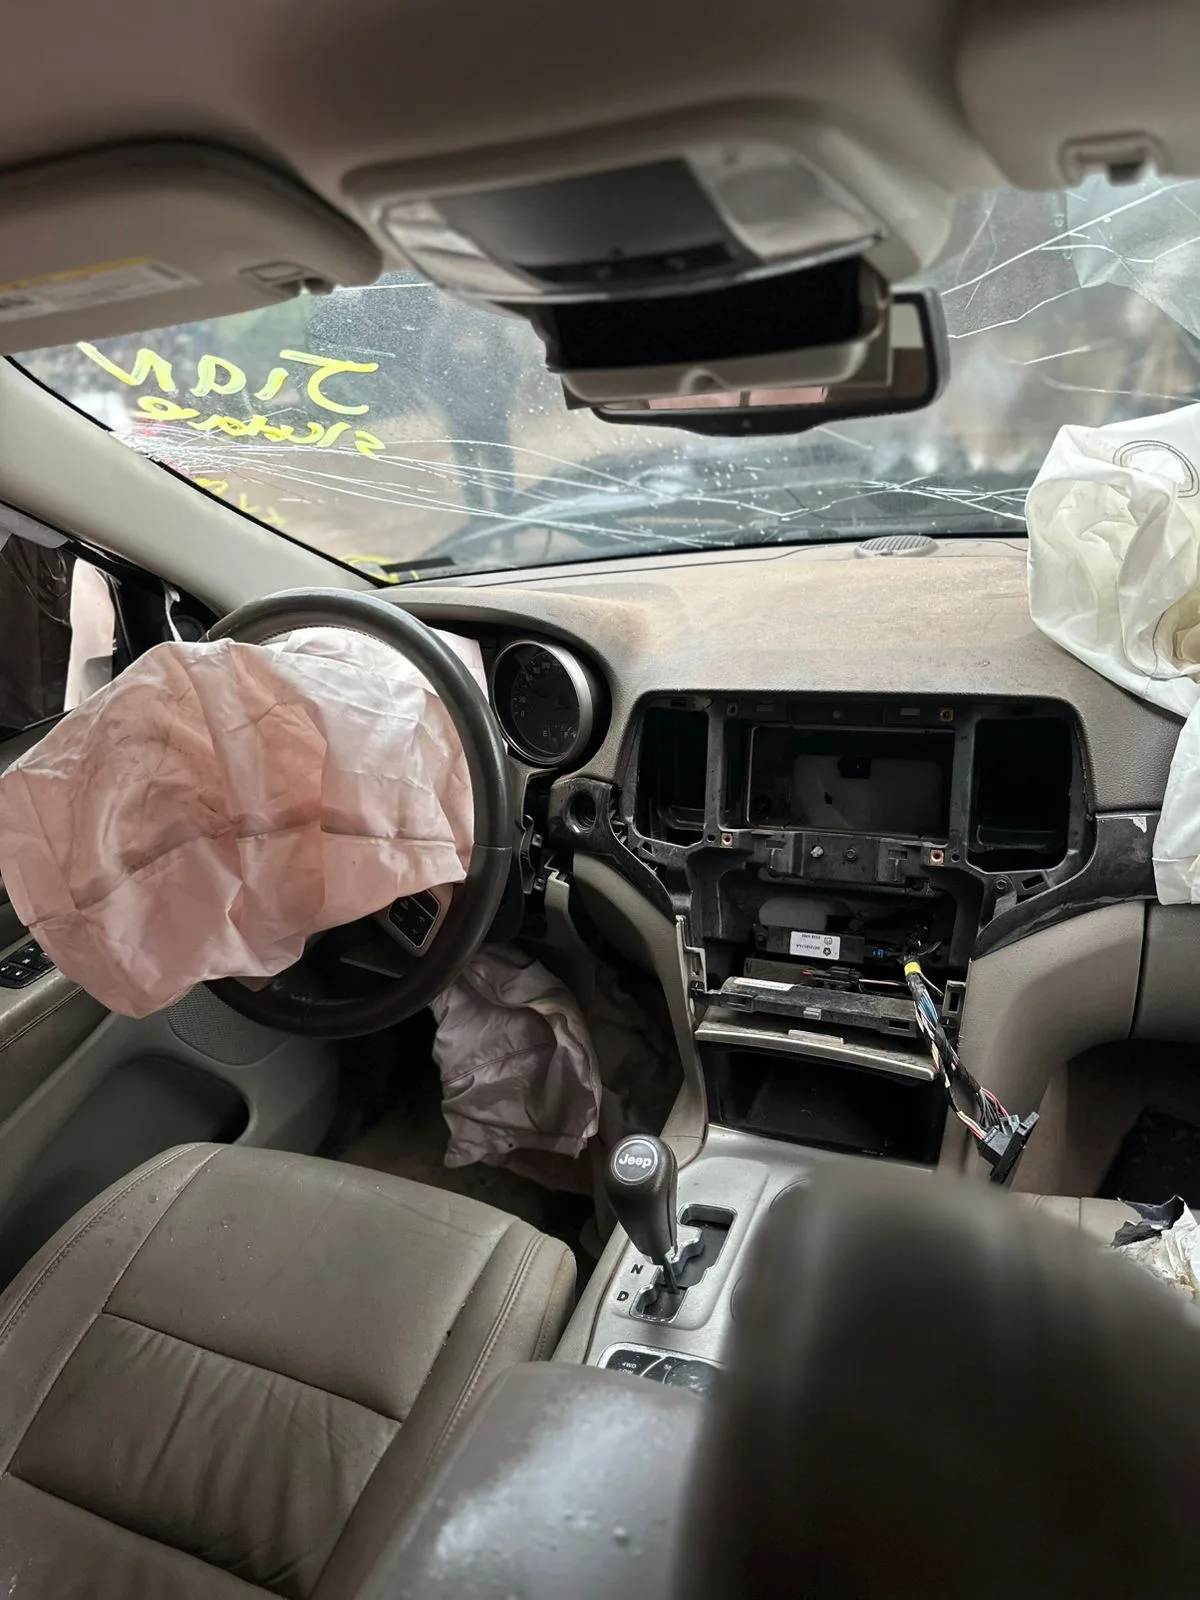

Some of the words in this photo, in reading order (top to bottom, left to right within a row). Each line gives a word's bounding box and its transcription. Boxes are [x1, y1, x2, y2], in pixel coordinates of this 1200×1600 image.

[619, 1153, 652, 1169] Jeep
[630, 1264, 643, 1274] N
[617, 1290, 629, 1301] D
